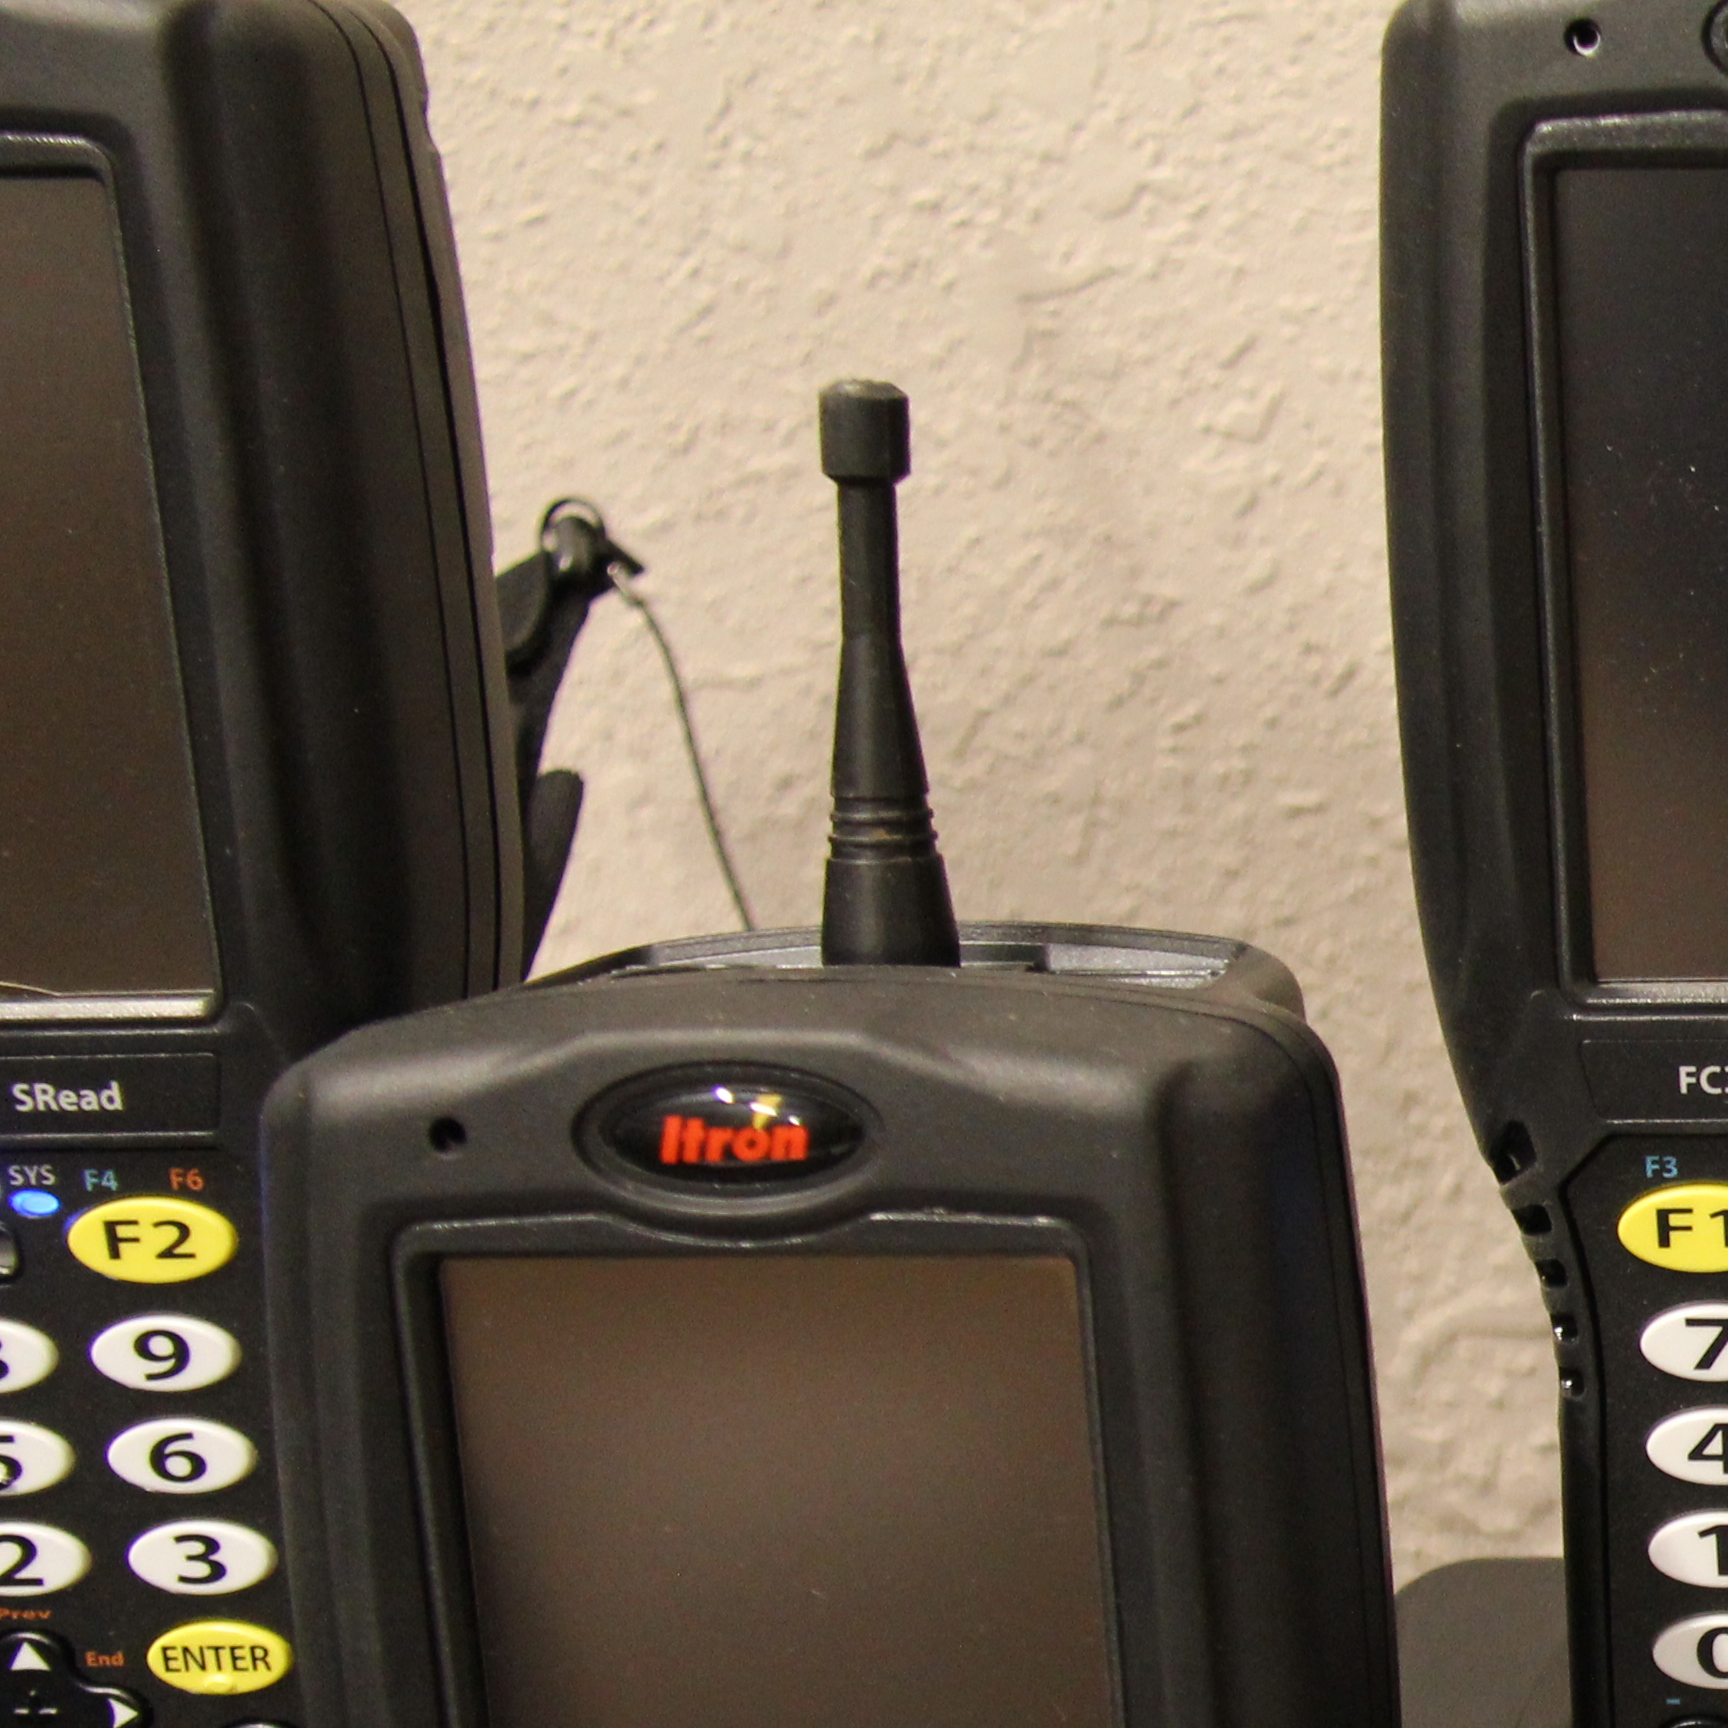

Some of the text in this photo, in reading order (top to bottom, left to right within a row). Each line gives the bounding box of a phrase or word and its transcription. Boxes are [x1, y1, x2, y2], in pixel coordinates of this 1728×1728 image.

[11, 1081, 123, 1112] SRead
[659, 1114, 809, 1165] Itron
[7, 1165, 56, 1186] SYS
[82, 1169, 119, 1191] F4
[170, 1168, 204, 1191] F6
[1645, 1156, 1678, 1178] F3
[103, 1219, 197, 1261] F2
[133, 1329, 191, 1382] 9
[149, 1432, 208, 1483] 6
[174, 1533, 228, 1585] 3
[86, 1651, 125, 1667] End
[161, 1645, 272, 1673] ENTER
